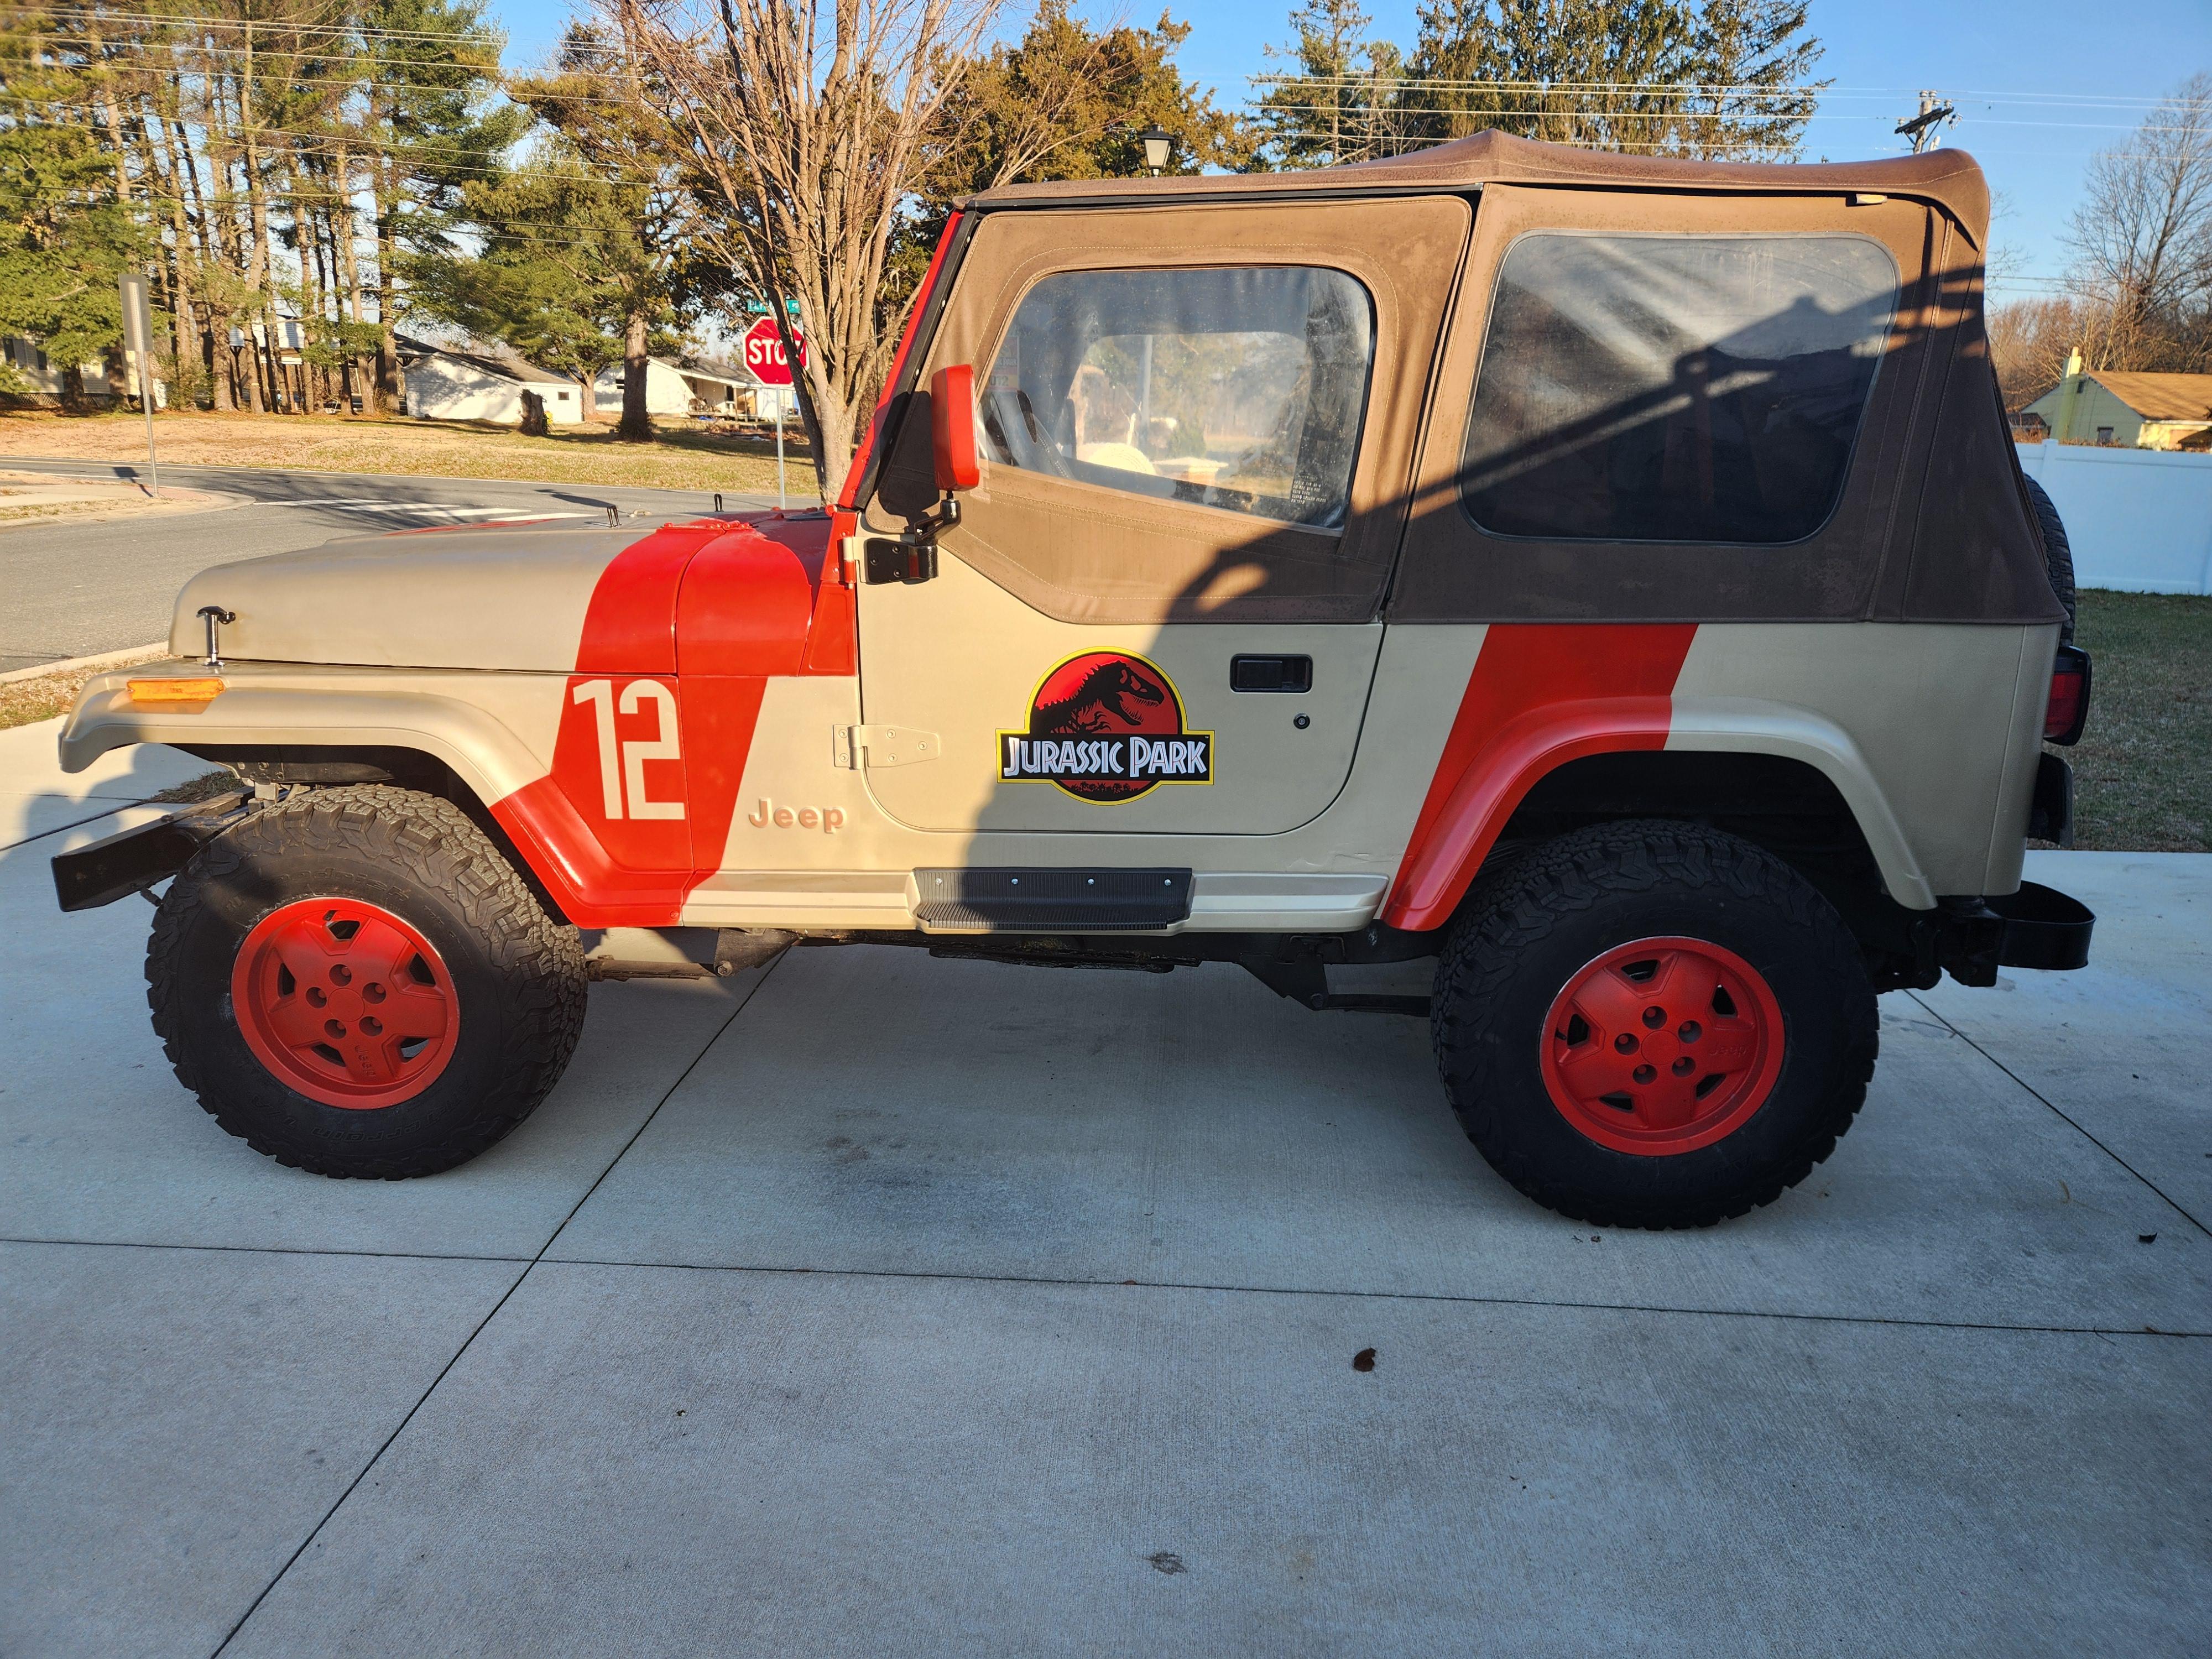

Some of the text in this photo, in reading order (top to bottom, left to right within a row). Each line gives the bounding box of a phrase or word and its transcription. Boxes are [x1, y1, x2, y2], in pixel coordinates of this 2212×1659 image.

[748, 338, 804, 366] STO
[573, 678, 686, 820] 12
[1004, 736, 1207, 778] JURASSIC PARK
[748, 797, 847, 834] Jeep
[354, 1044, 376, 1076] Jeep
